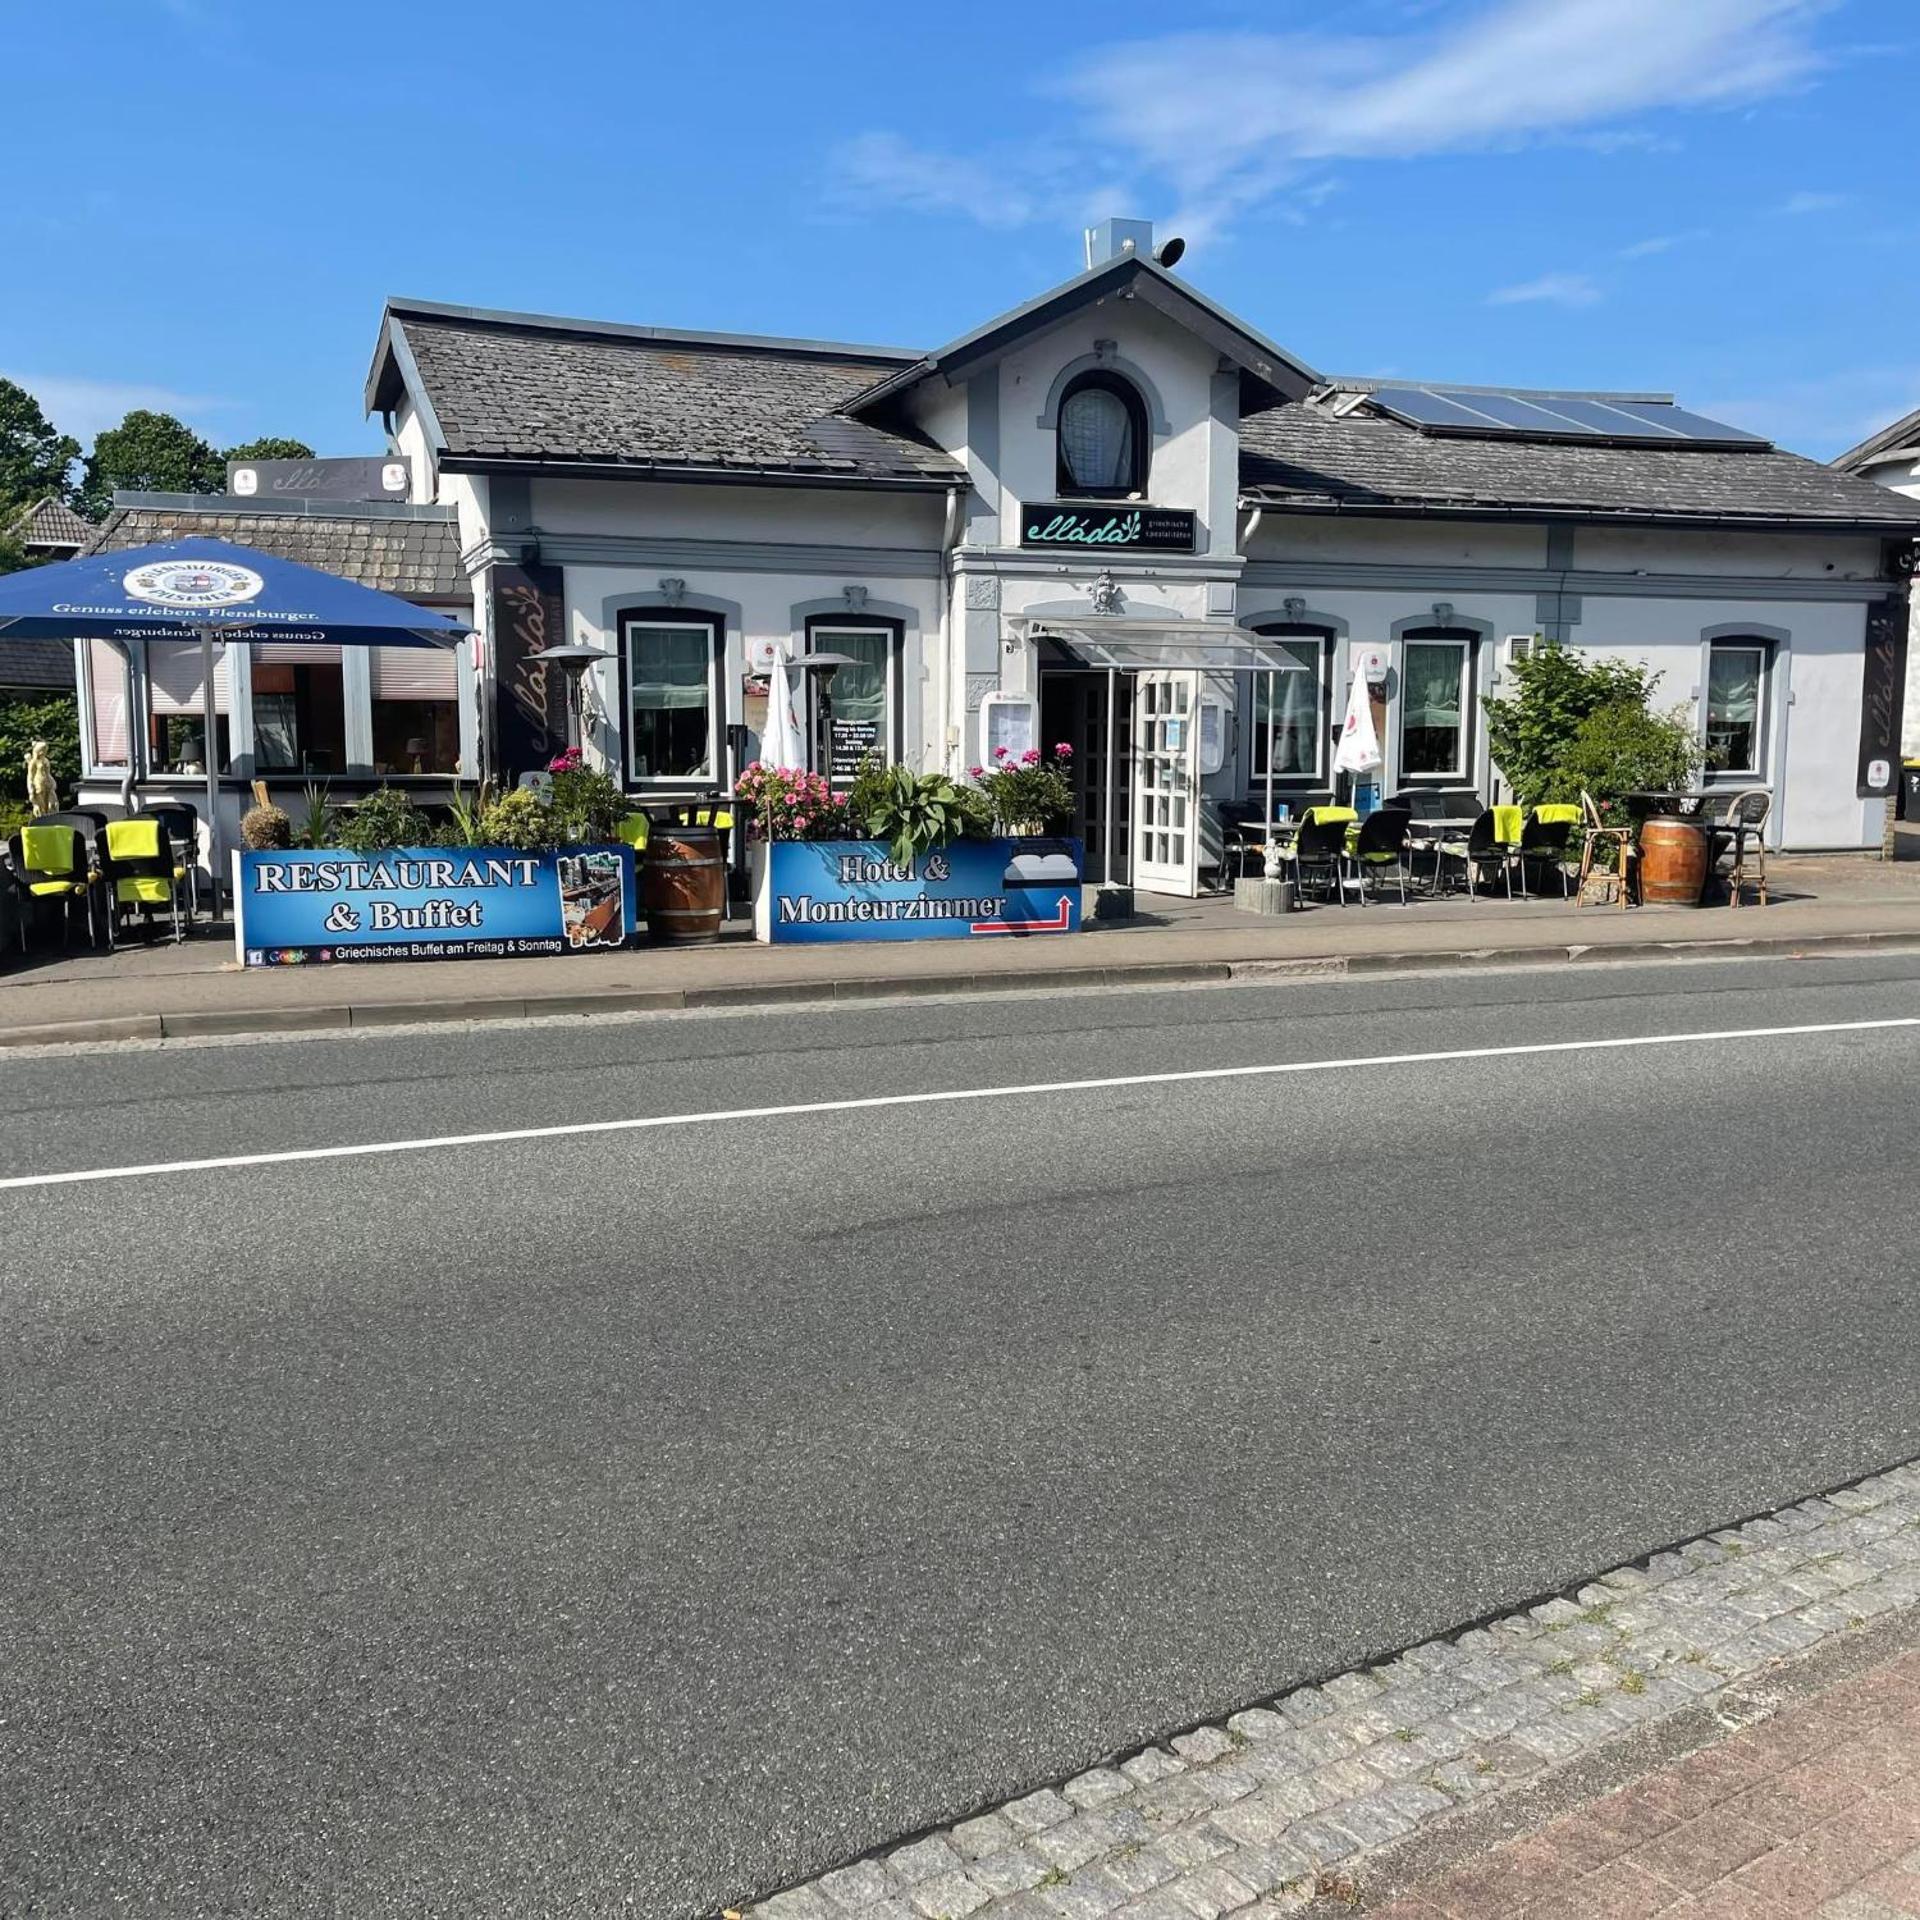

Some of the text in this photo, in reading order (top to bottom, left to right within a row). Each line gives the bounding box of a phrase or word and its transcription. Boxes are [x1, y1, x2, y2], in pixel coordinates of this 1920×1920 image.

[1027, 515, 1130, 544] elláda
[141, 564, 249, 581] FLENSBURGER
[148, 589, 236, 602] PILSENER
[52, 603, 320, 621] Genuss erleben. Flensburger.
[255, 858, 540, 893] RESTAURANT
[839, 853, 950, 883] Hotel &
[324, 899, 483, 932] & Buffet
[777, 892, 1007, 923] Monteurzimmer
[335, 939, 562, 959] Griechisches Buffet am Freitag & Sonntag
